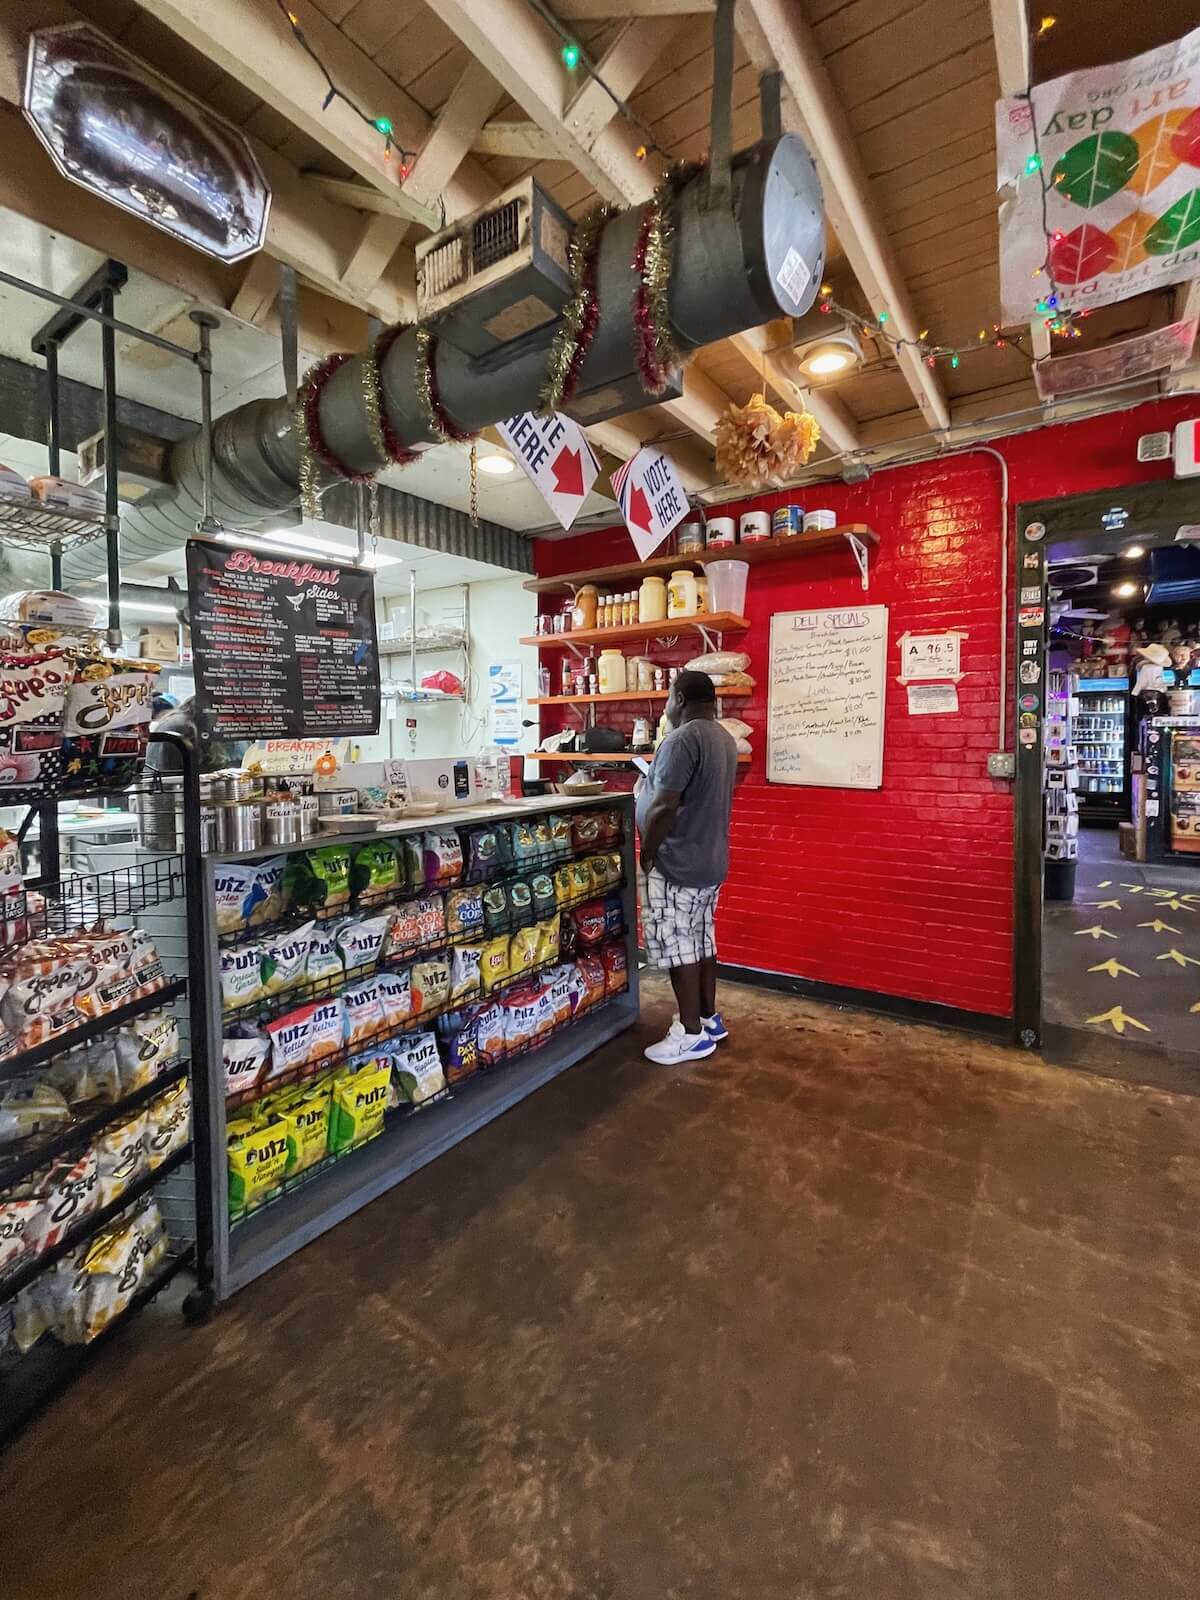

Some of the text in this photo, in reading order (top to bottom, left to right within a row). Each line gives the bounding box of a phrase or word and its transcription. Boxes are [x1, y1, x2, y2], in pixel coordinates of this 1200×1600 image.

[1041, 106, 1114, 137] day
[502, 414, 550, 475] HERE
[643, 455, 671, 497] VOTE
[655, 487, 681, 528] HERE
[225, 551, 340, 586] Breakfast
[306, 585, 340, 601] Sides
[793, 611, 870, 628] DELI SPECIALS
[909, 645, 919, 655] A
[267, 740, 330, 752] BREAKFAST
